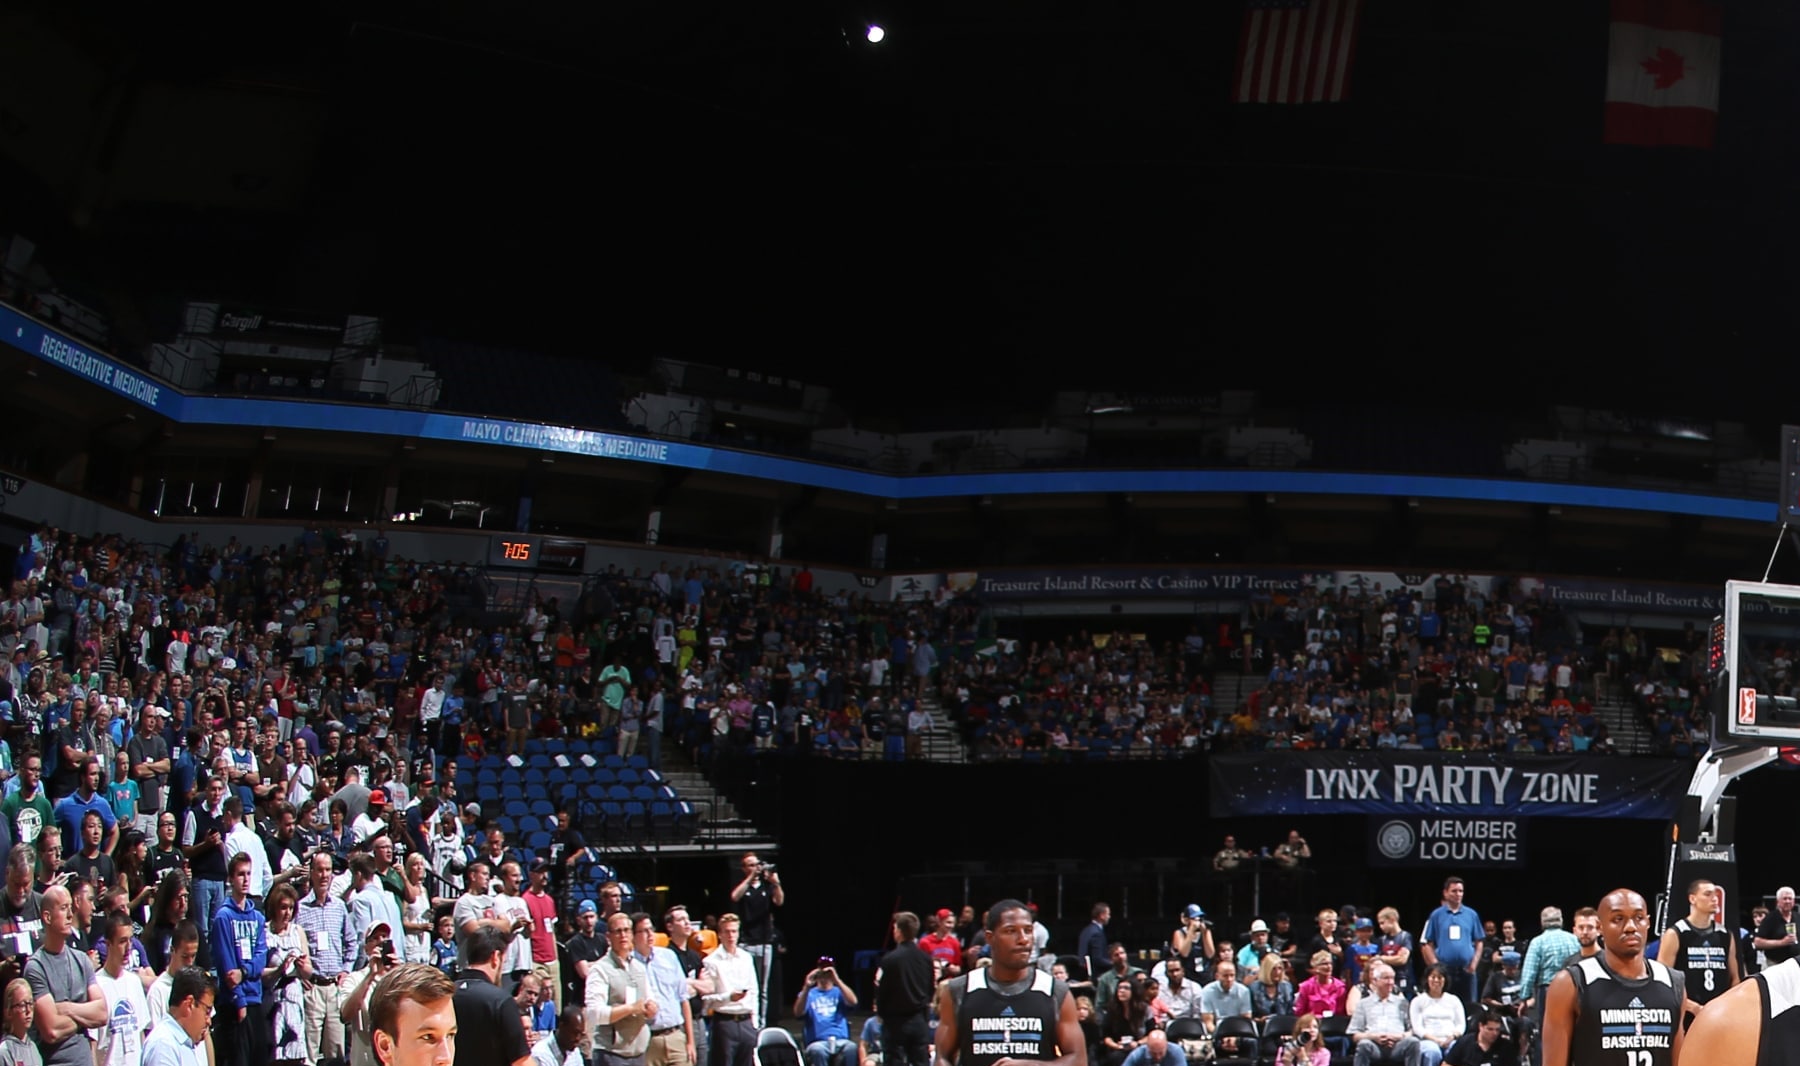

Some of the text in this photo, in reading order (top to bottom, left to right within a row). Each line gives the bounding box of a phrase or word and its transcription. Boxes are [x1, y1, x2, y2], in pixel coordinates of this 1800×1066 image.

[220, 313, 263, 332] Cargill
[40, 333, 160, 407] REGENERATIVE MEDICINE
[463, 421, 501, 441] MAYO
[504, 425, 548, 445] CLINIC
[606, 437, 667, 461] MEDICINE
[502, 541, 531, 561] 7:05
[981, 573, 1299, 592] Treasure Island Resort & Casino VIP Terrace
[1551, 584, 1609, 604] Treasure
[1611, 589, 1652, 607] Island
[1656, 591, 1699, 608] Resort
[1702, 595, 1716, 608] &
[1306, 764, 1600, 805] LYNX PARTY ZONE
[1419, 819, 1517, 840] MEMBER
[1419, 841, 1517, 862] LOUNGE
[1689, 850, 1729, 862] SPALDING
[1688, 947, 1726, 956] MINNESOTA
[1689, 960, 1727, 970] BASKETBALL
[1704, 970, 1715, 991] 8
[972, 1018, 1043, 1032] MINNESOTA
[1601, 1008, 1672, 1025] MINNESOTA
[973, 1042, 1040, 1055] BASKETBALL
[1602, 1034, 1670, 1050] BASKETBALL
